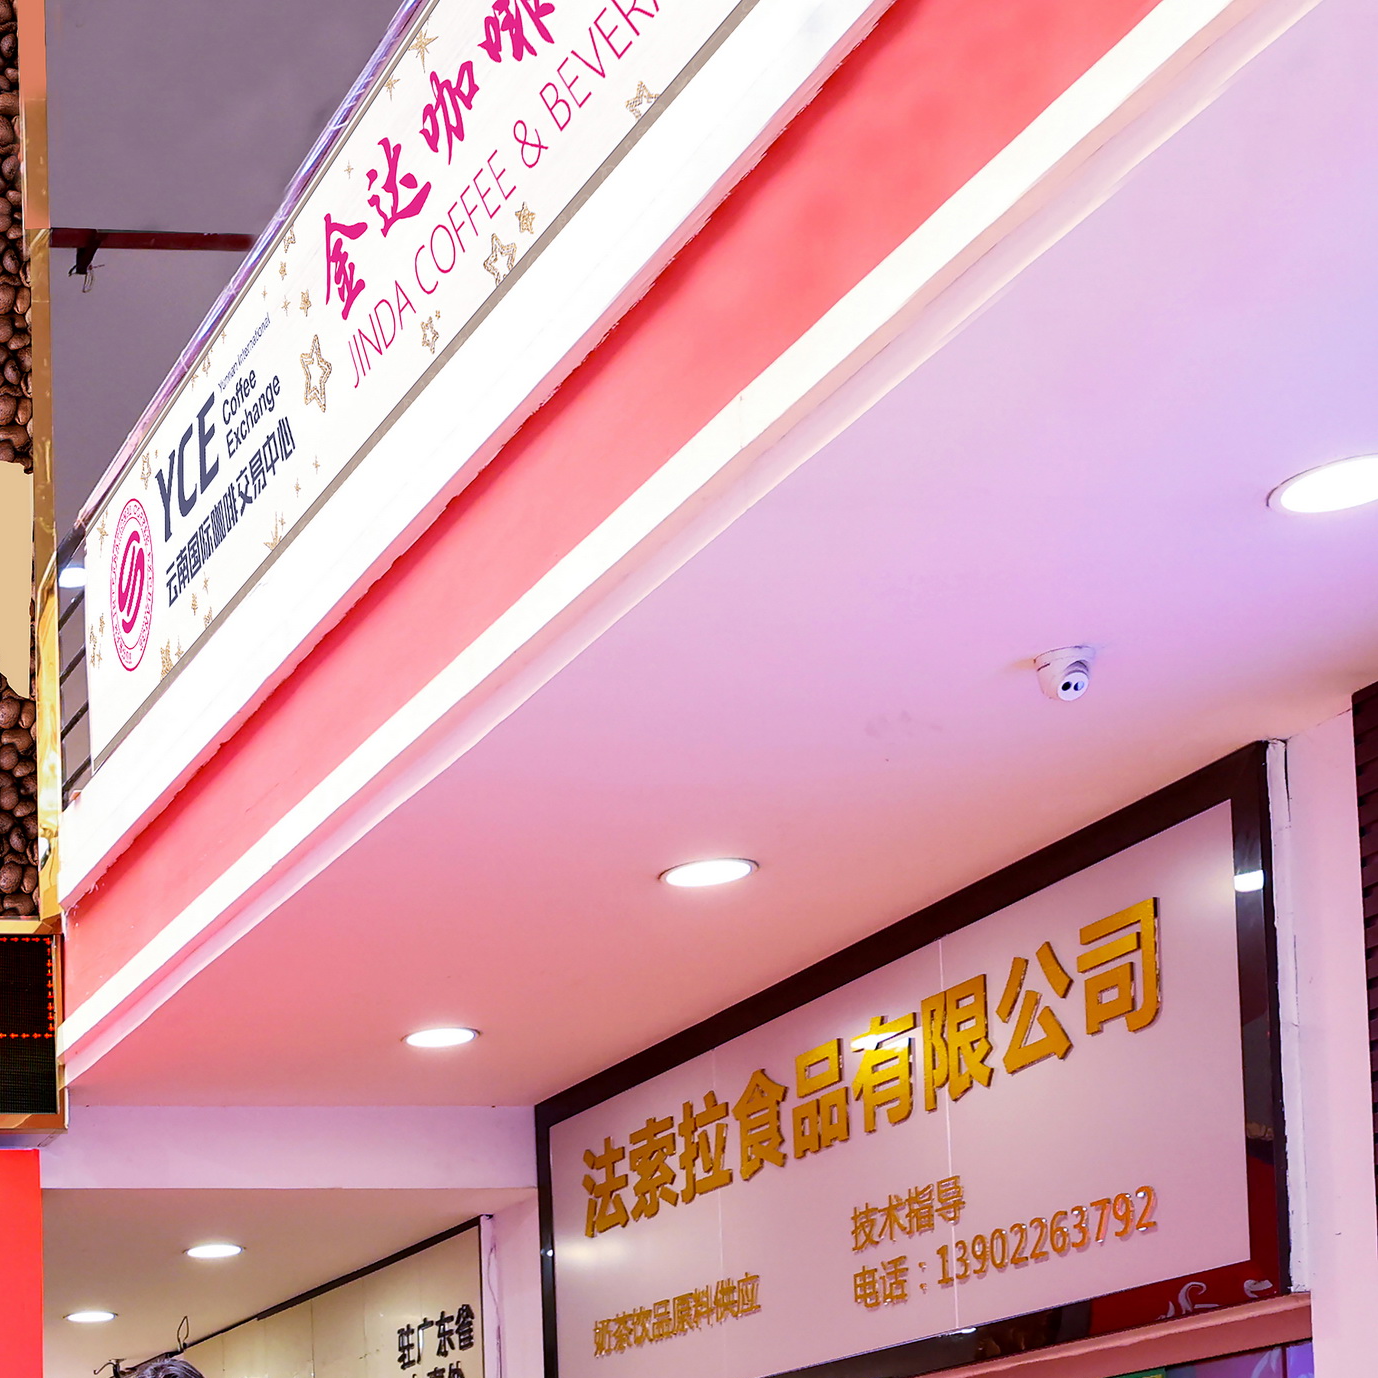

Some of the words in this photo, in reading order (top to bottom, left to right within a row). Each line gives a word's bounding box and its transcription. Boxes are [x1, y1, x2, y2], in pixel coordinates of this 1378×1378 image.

[348, 280, 416, 388] JINDA
[414, 149, 517, 295] COFFEE
[513, 119, 549, 168] &
[539, 0, 660, 131] BEVER
[222, 369, 257, 426] Coffee
[227, 375, 281, 459] Exchange
[154, 391, 220, 543] YCE
[165, 416, 296, 608] 云南国际咖啡交易中心
[582, 896, 1161, 1238] 法索拉食品有限公司
[851, 1176, 966, 1254] 技术指导
[592, 1271, 762, 1358] 奶茶饮品原料供应
